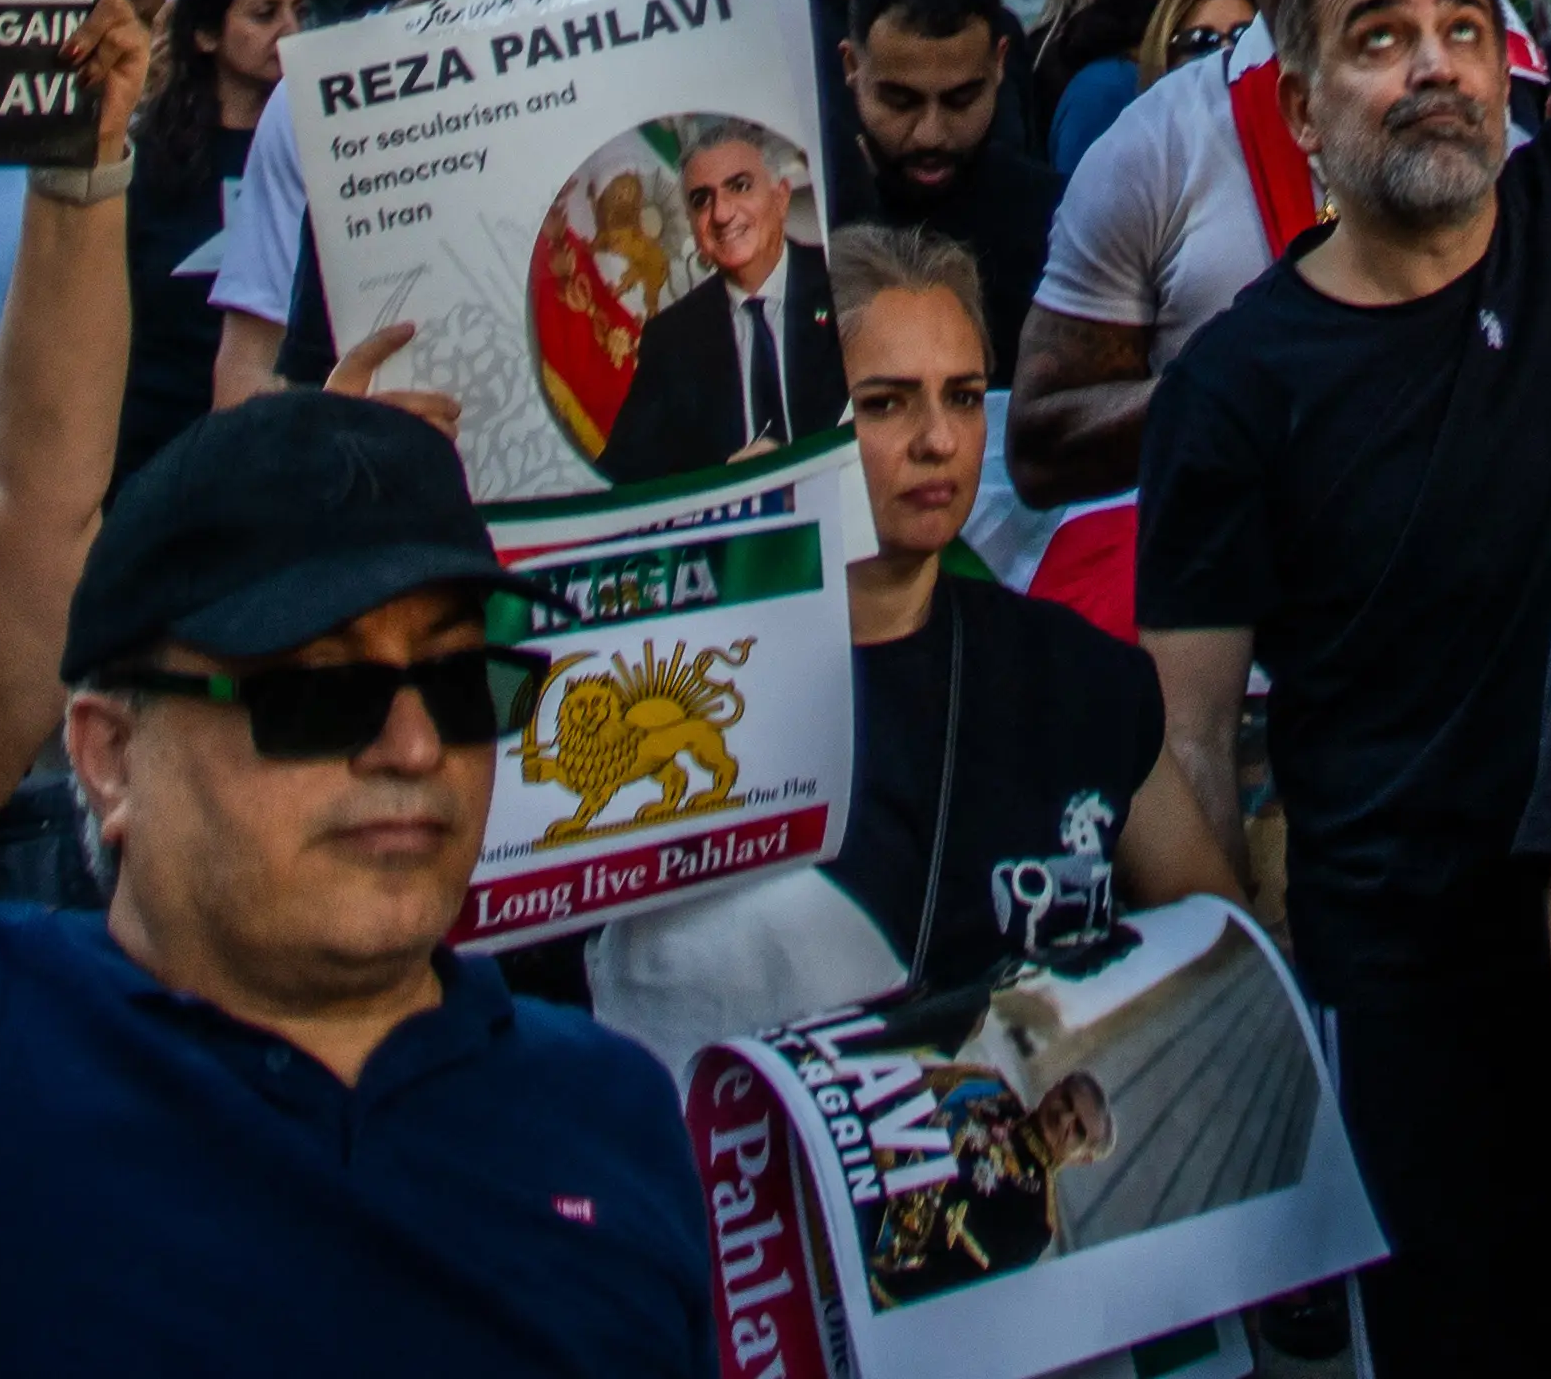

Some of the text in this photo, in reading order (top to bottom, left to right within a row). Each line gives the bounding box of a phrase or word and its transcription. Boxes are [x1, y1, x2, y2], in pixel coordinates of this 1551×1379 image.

[319, 47, 474, 117] REZA
[330, 81, 577, 163] for secularism and
[339, 145, 489, 201] democracy
[345, 204, 433, 240] in Iran
[475, 823, 789, 931] Long live Pahlavi
